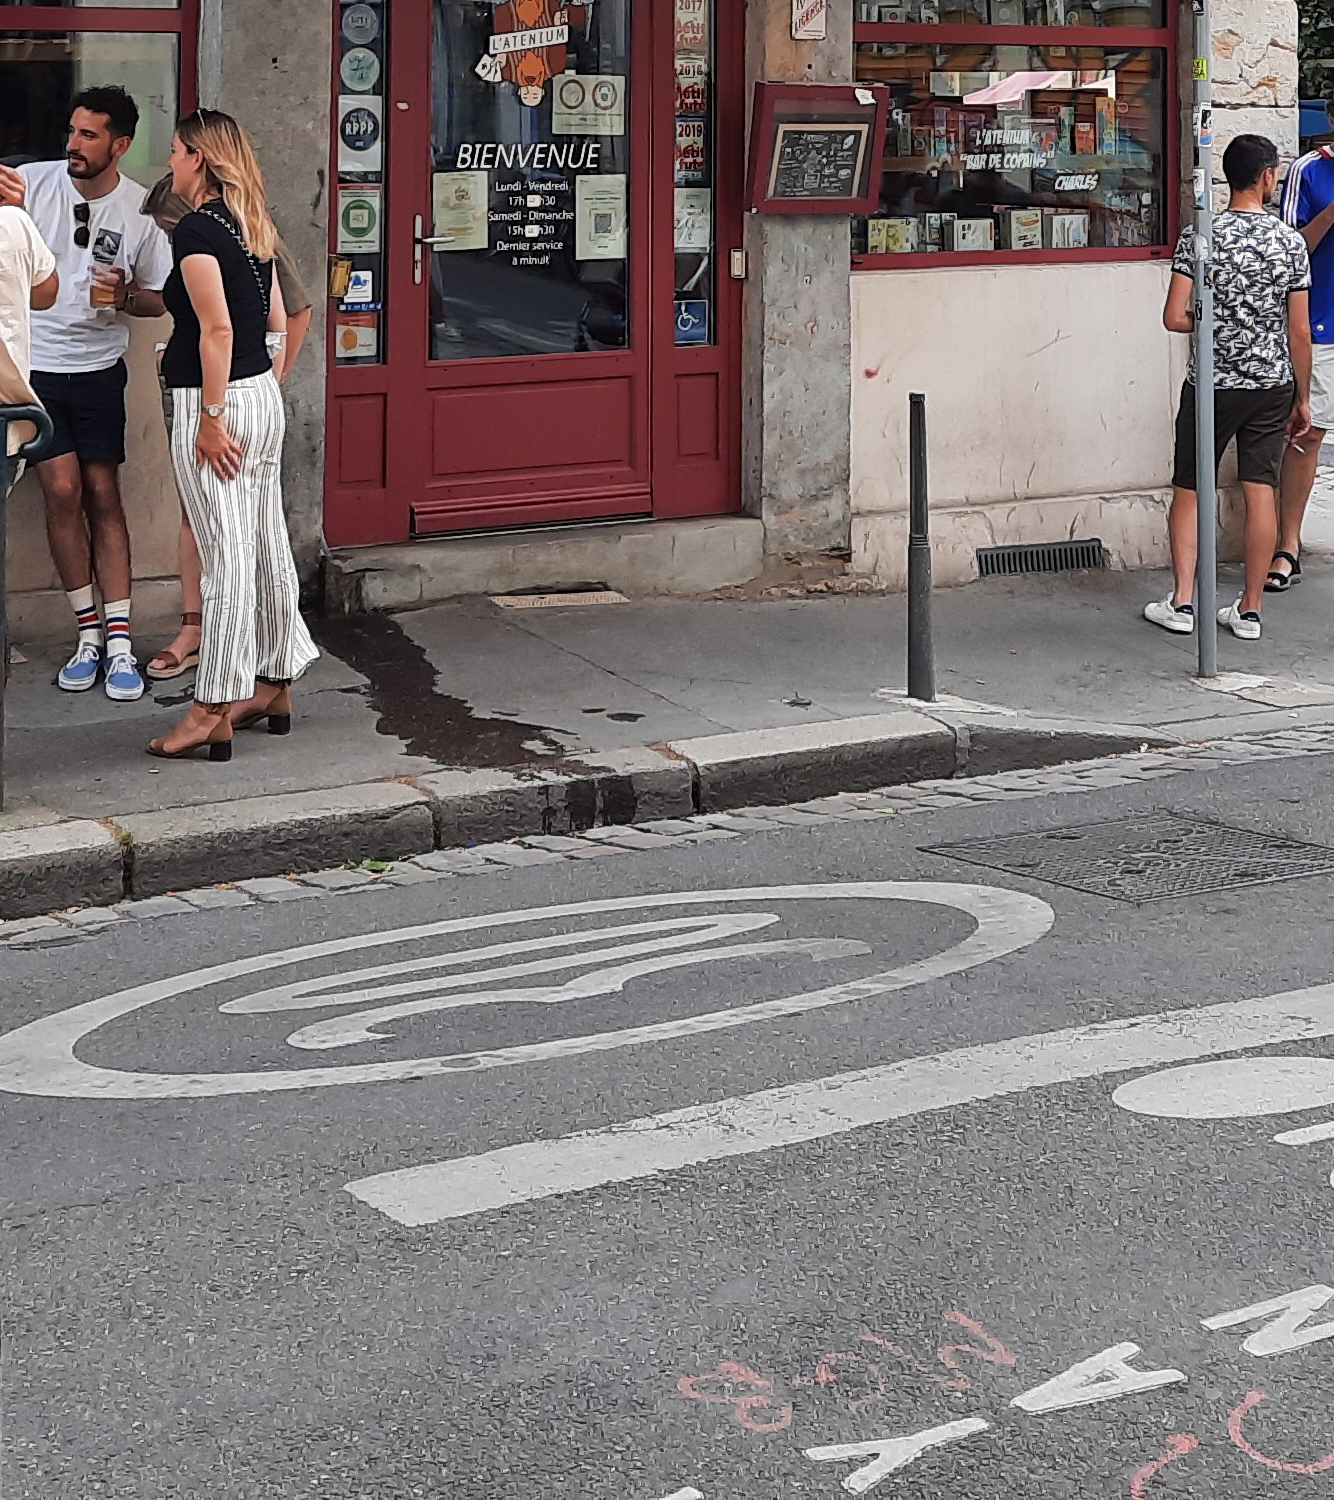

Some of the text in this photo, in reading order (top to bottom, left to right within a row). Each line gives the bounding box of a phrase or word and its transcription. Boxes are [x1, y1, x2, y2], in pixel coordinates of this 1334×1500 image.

[492, 27, 566, 51] L'ATENIUM
[455, 143, 602, 169] BIENVENUE
[495, 180, 522, 192] Lundi
[528, 180, 569, 192] Vendredi
[487, 212, 522, 222] Samedi
[528, 212, 574, 222] Dimanche
